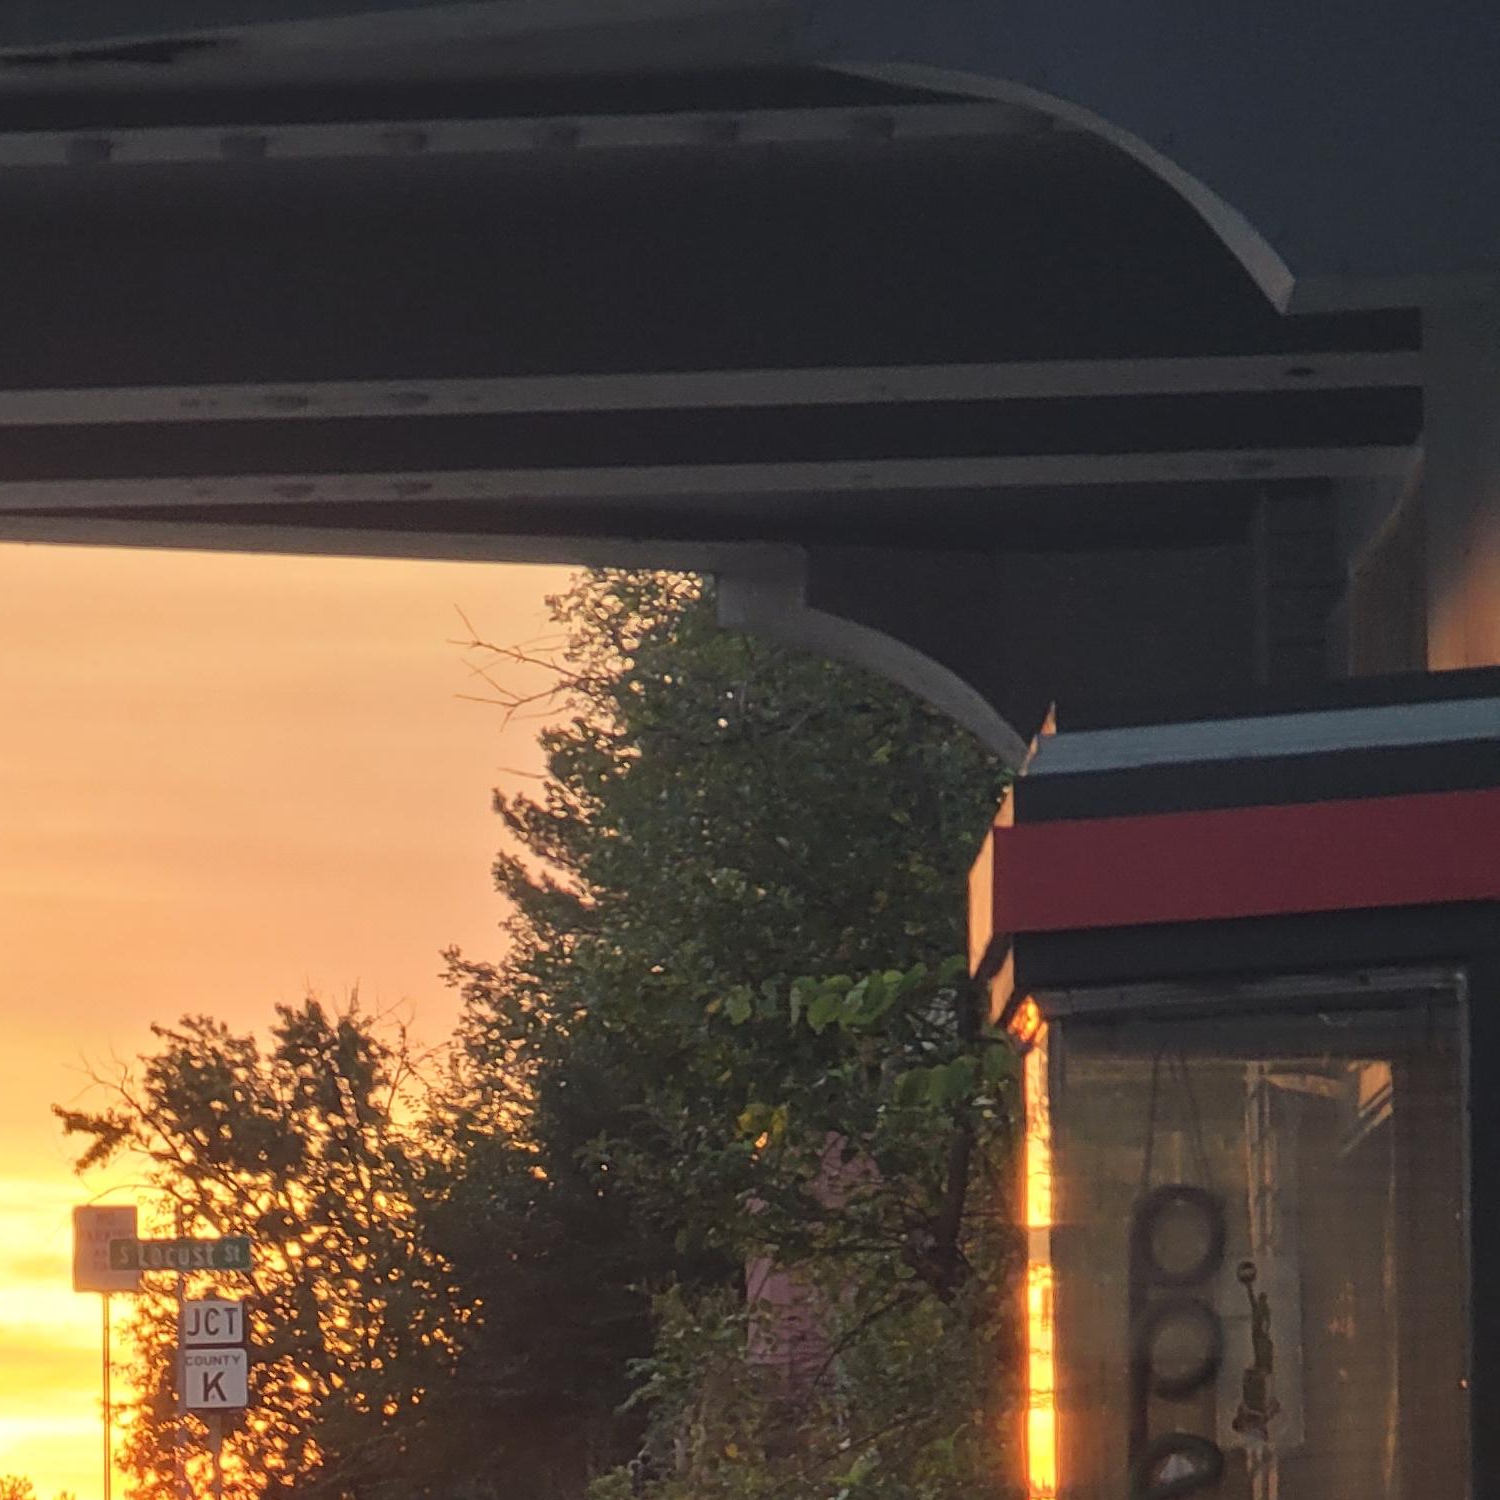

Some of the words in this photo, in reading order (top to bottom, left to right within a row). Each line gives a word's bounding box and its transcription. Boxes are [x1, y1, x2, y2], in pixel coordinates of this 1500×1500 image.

[186, 1307, 238, 1336] JCT
[185, 1354, 241, 1367] COUNTY
[203, 1370, 227, 1402] K
